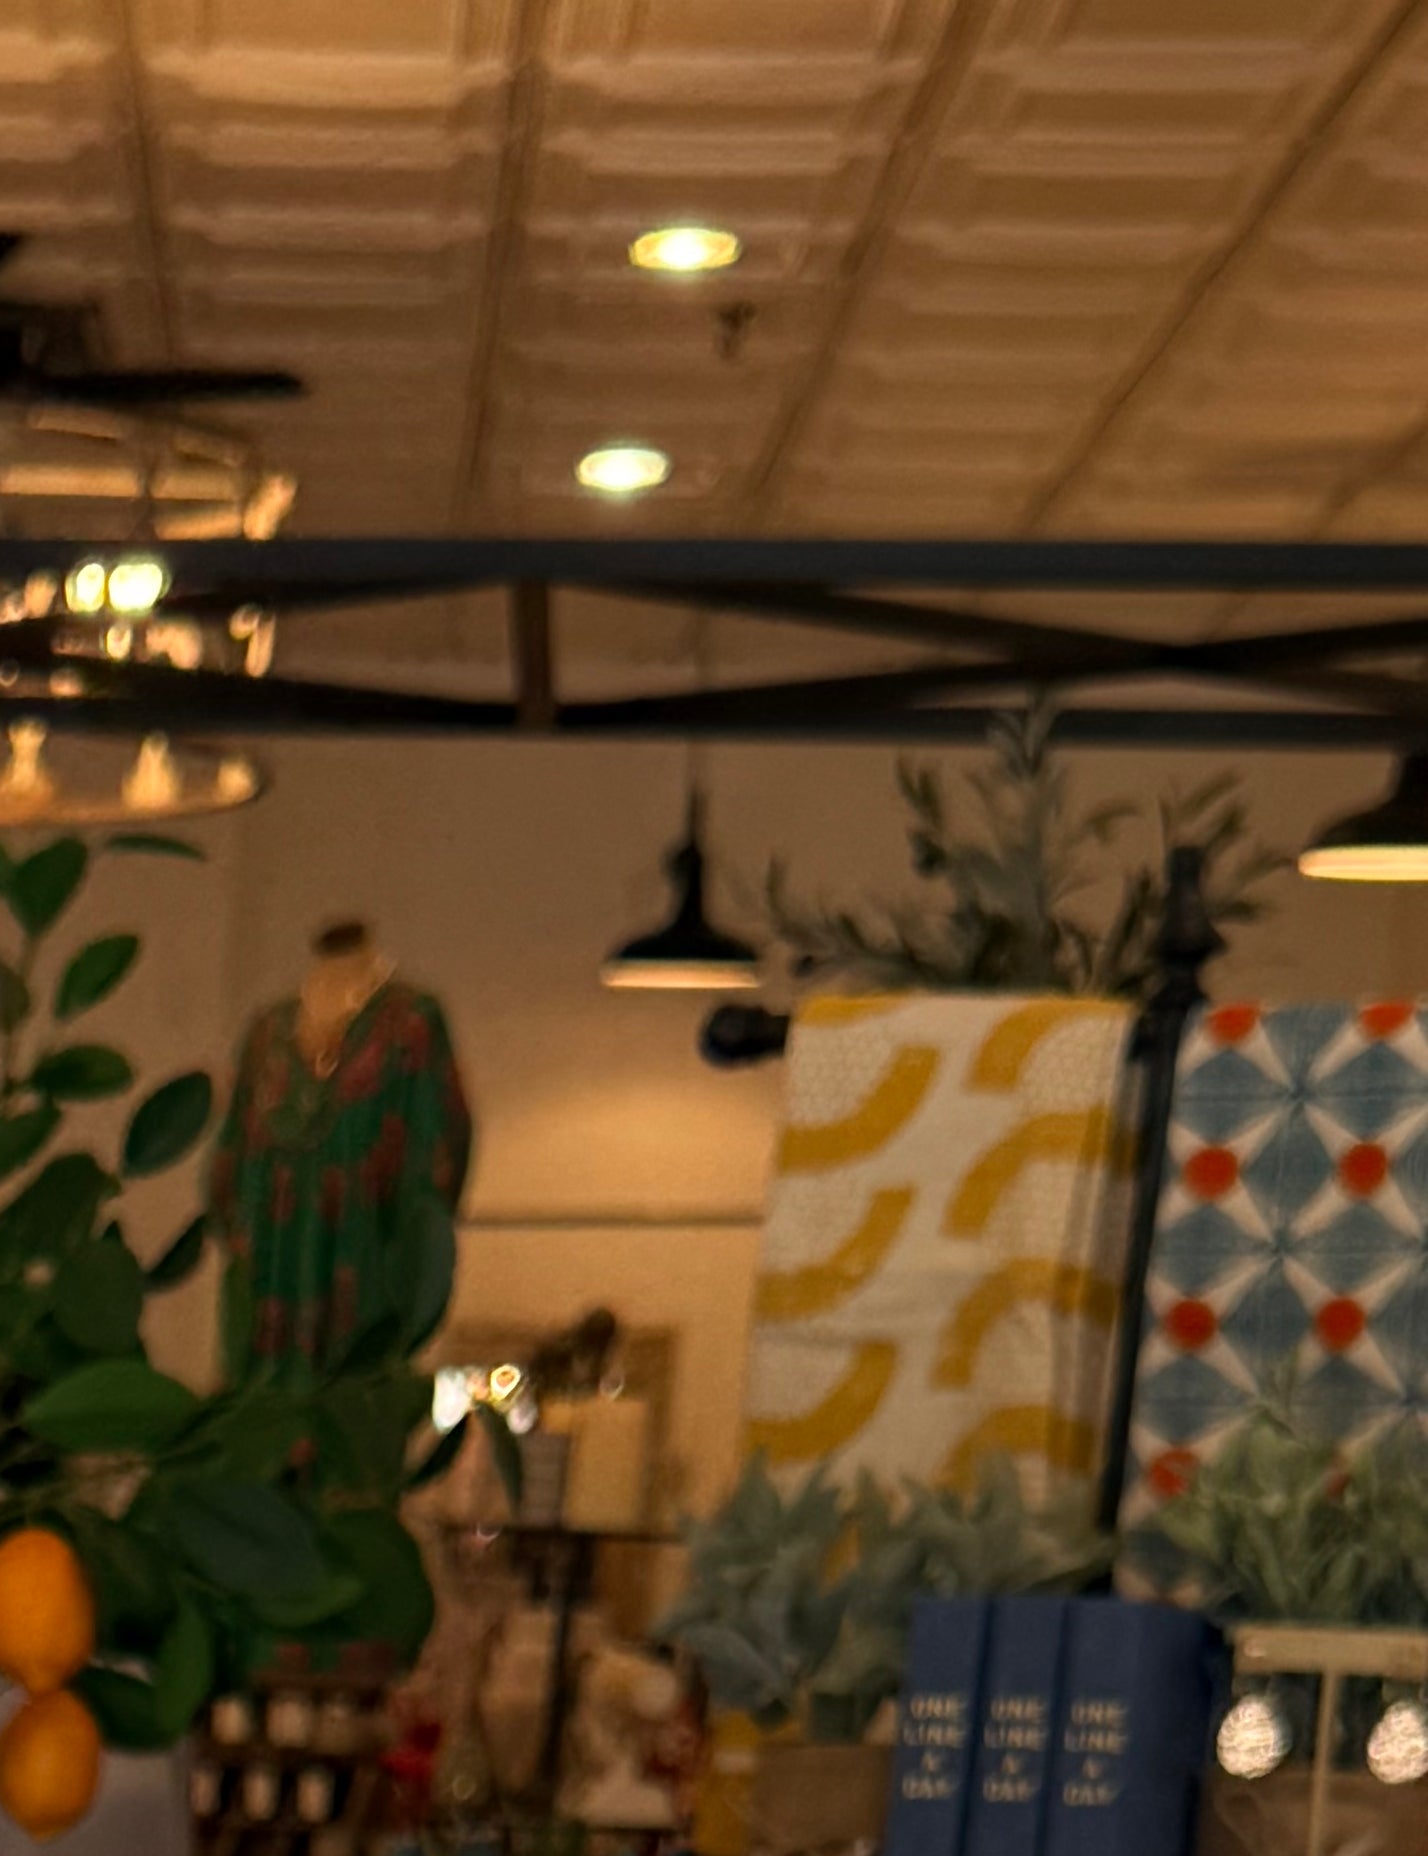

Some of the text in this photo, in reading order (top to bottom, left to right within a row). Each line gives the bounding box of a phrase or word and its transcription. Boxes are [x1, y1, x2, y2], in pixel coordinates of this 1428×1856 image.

[910, 1697, 963, 1721] ONE
[991, 1699, 1045, 1724] ONE
[1071, 1702, 1126, 1727] ONE
[903, 1723, 965, 1749] LINE
[984, 1725, 1046, 1751] LINE
[1064, 1730, 1126, 1755] LINE
[902, 1774, 956, 1800] DAY
[983, 1777, 1037, 1803] DAY
[1063, 1781, 1115, 1807] DAY
